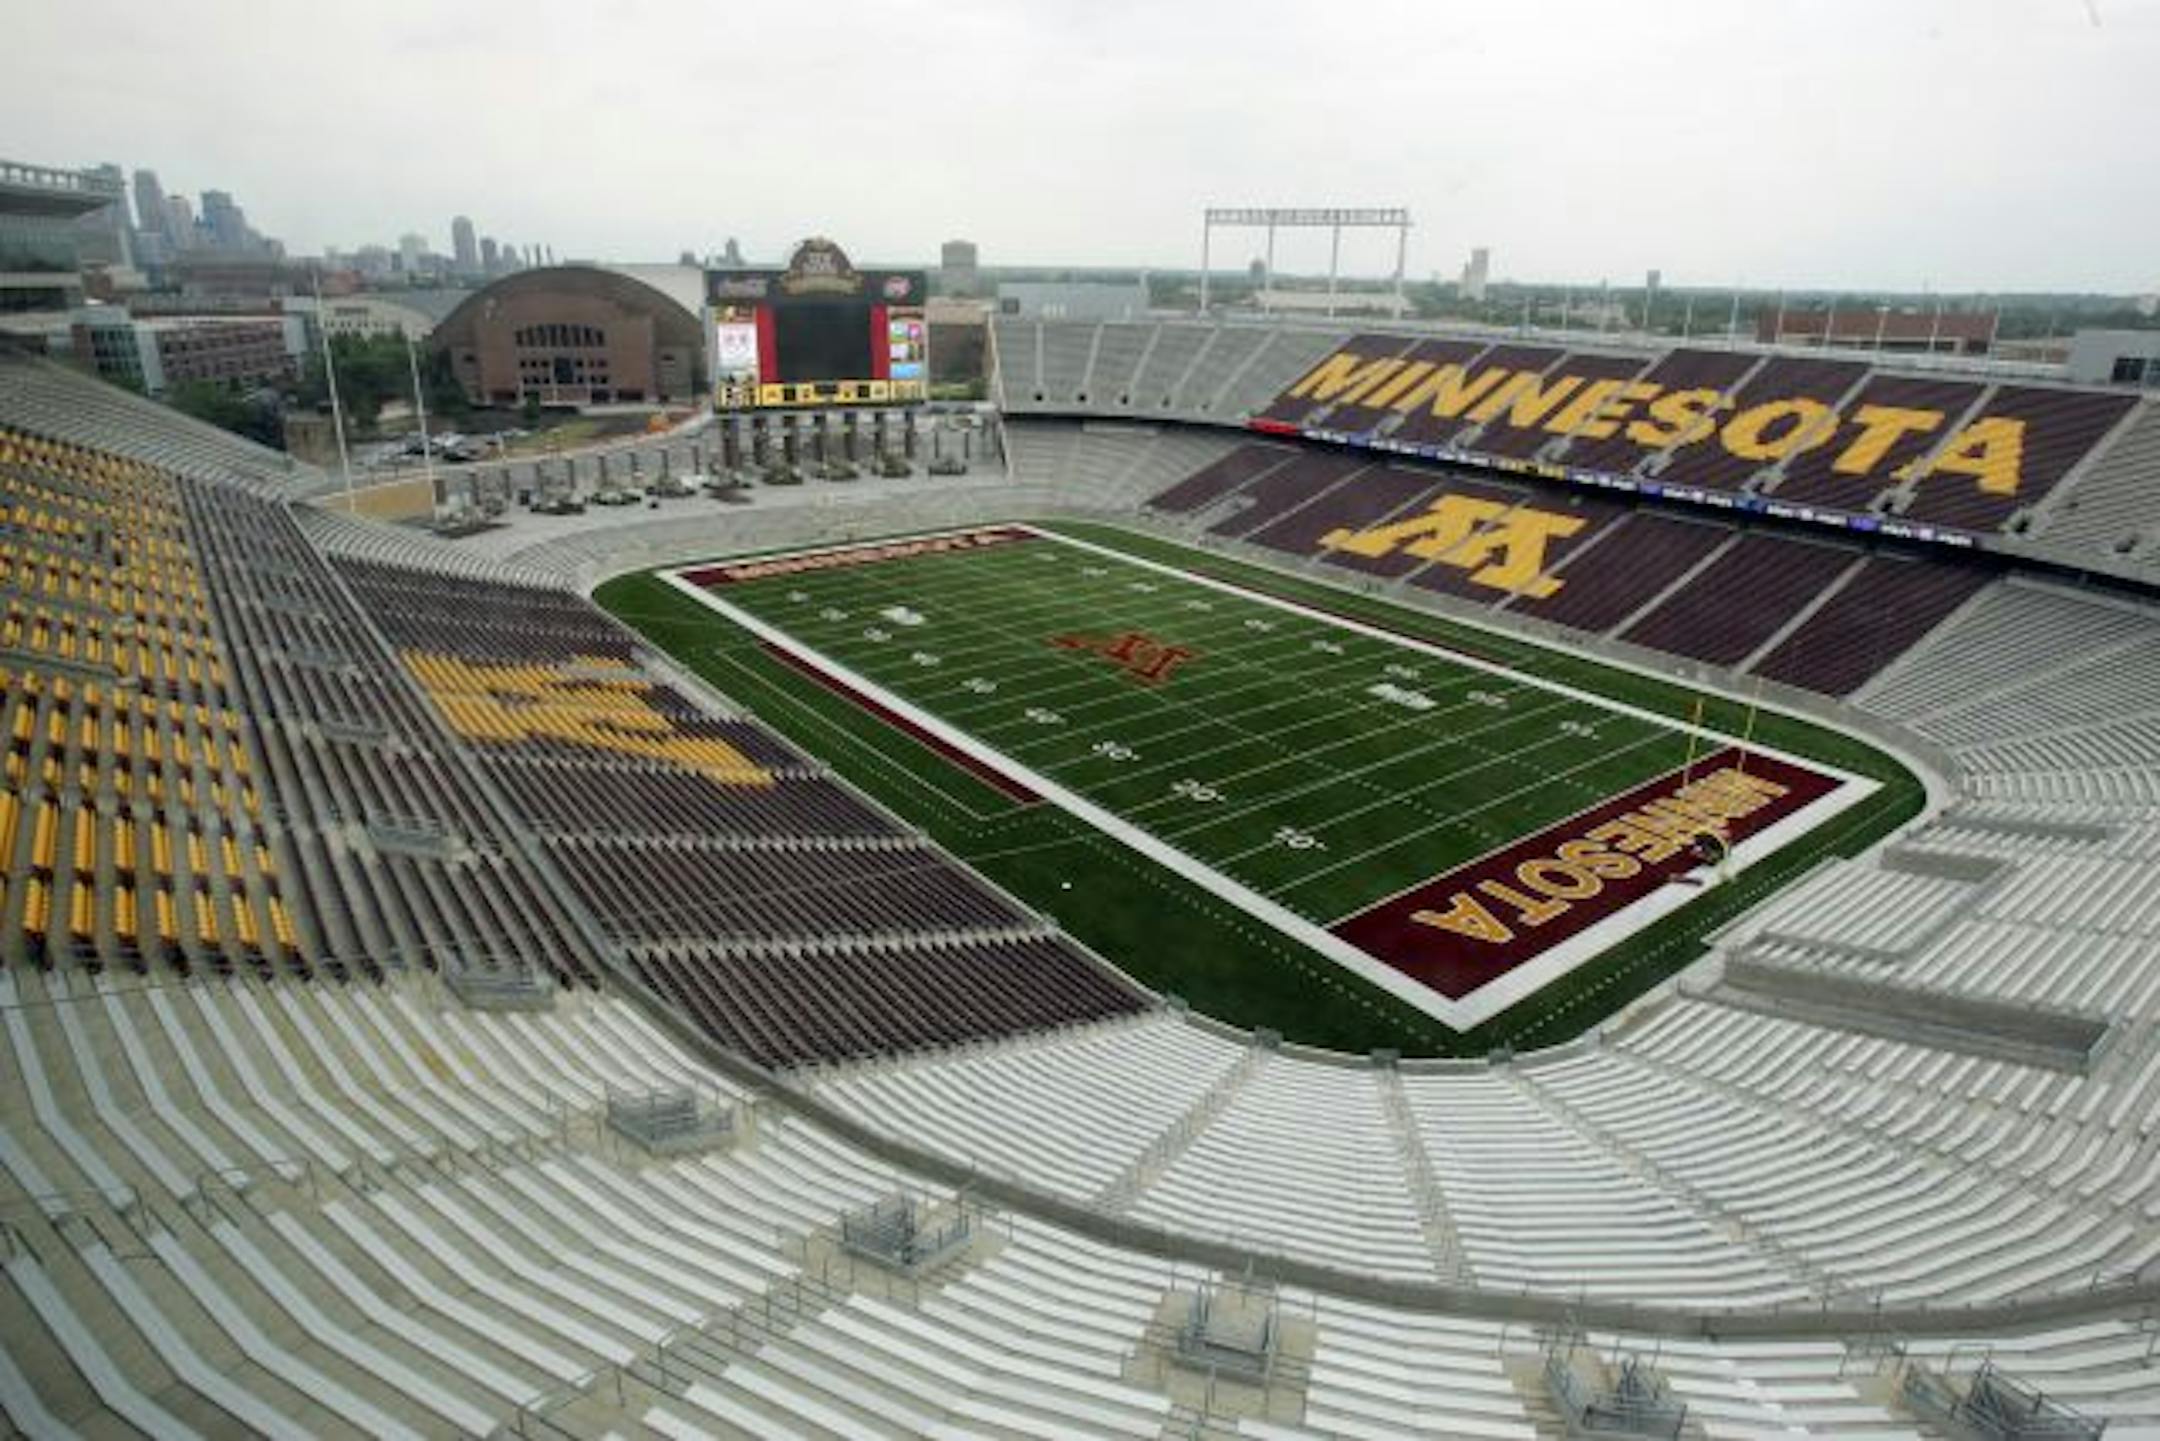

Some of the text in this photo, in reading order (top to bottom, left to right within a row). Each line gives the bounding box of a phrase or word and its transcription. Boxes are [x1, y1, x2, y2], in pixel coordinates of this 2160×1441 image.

[1287, 353, 2028, 496] MINNESOTA
[1319, 493, 1588, 598] M
[1409, 767, 1792, 944] MINNESOTA
